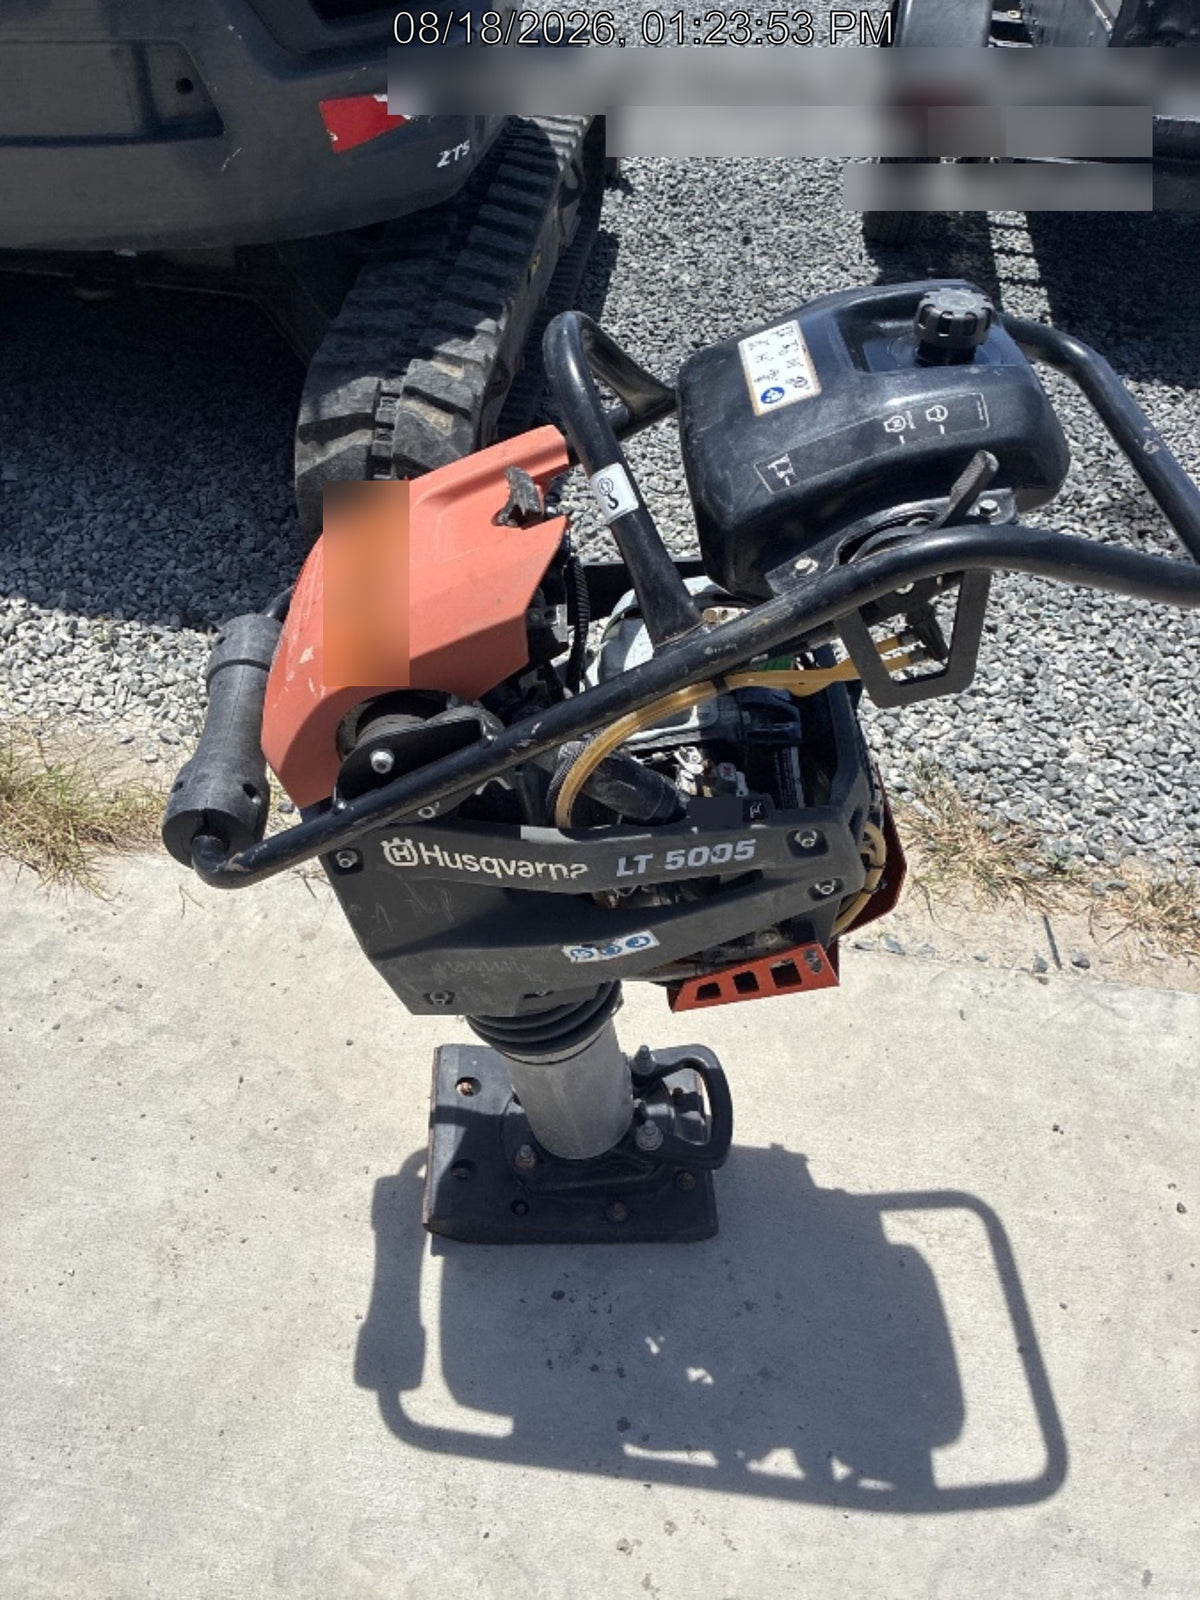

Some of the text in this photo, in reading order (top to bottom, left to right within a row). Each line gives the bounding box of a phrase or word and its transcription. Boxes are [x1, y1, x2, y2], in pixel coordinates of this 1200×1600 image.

[436, 139, 470, 168] ZTS
[420, 842, 588, 880] Husqvarna
[616, 839, 756, 877] LT 5005
